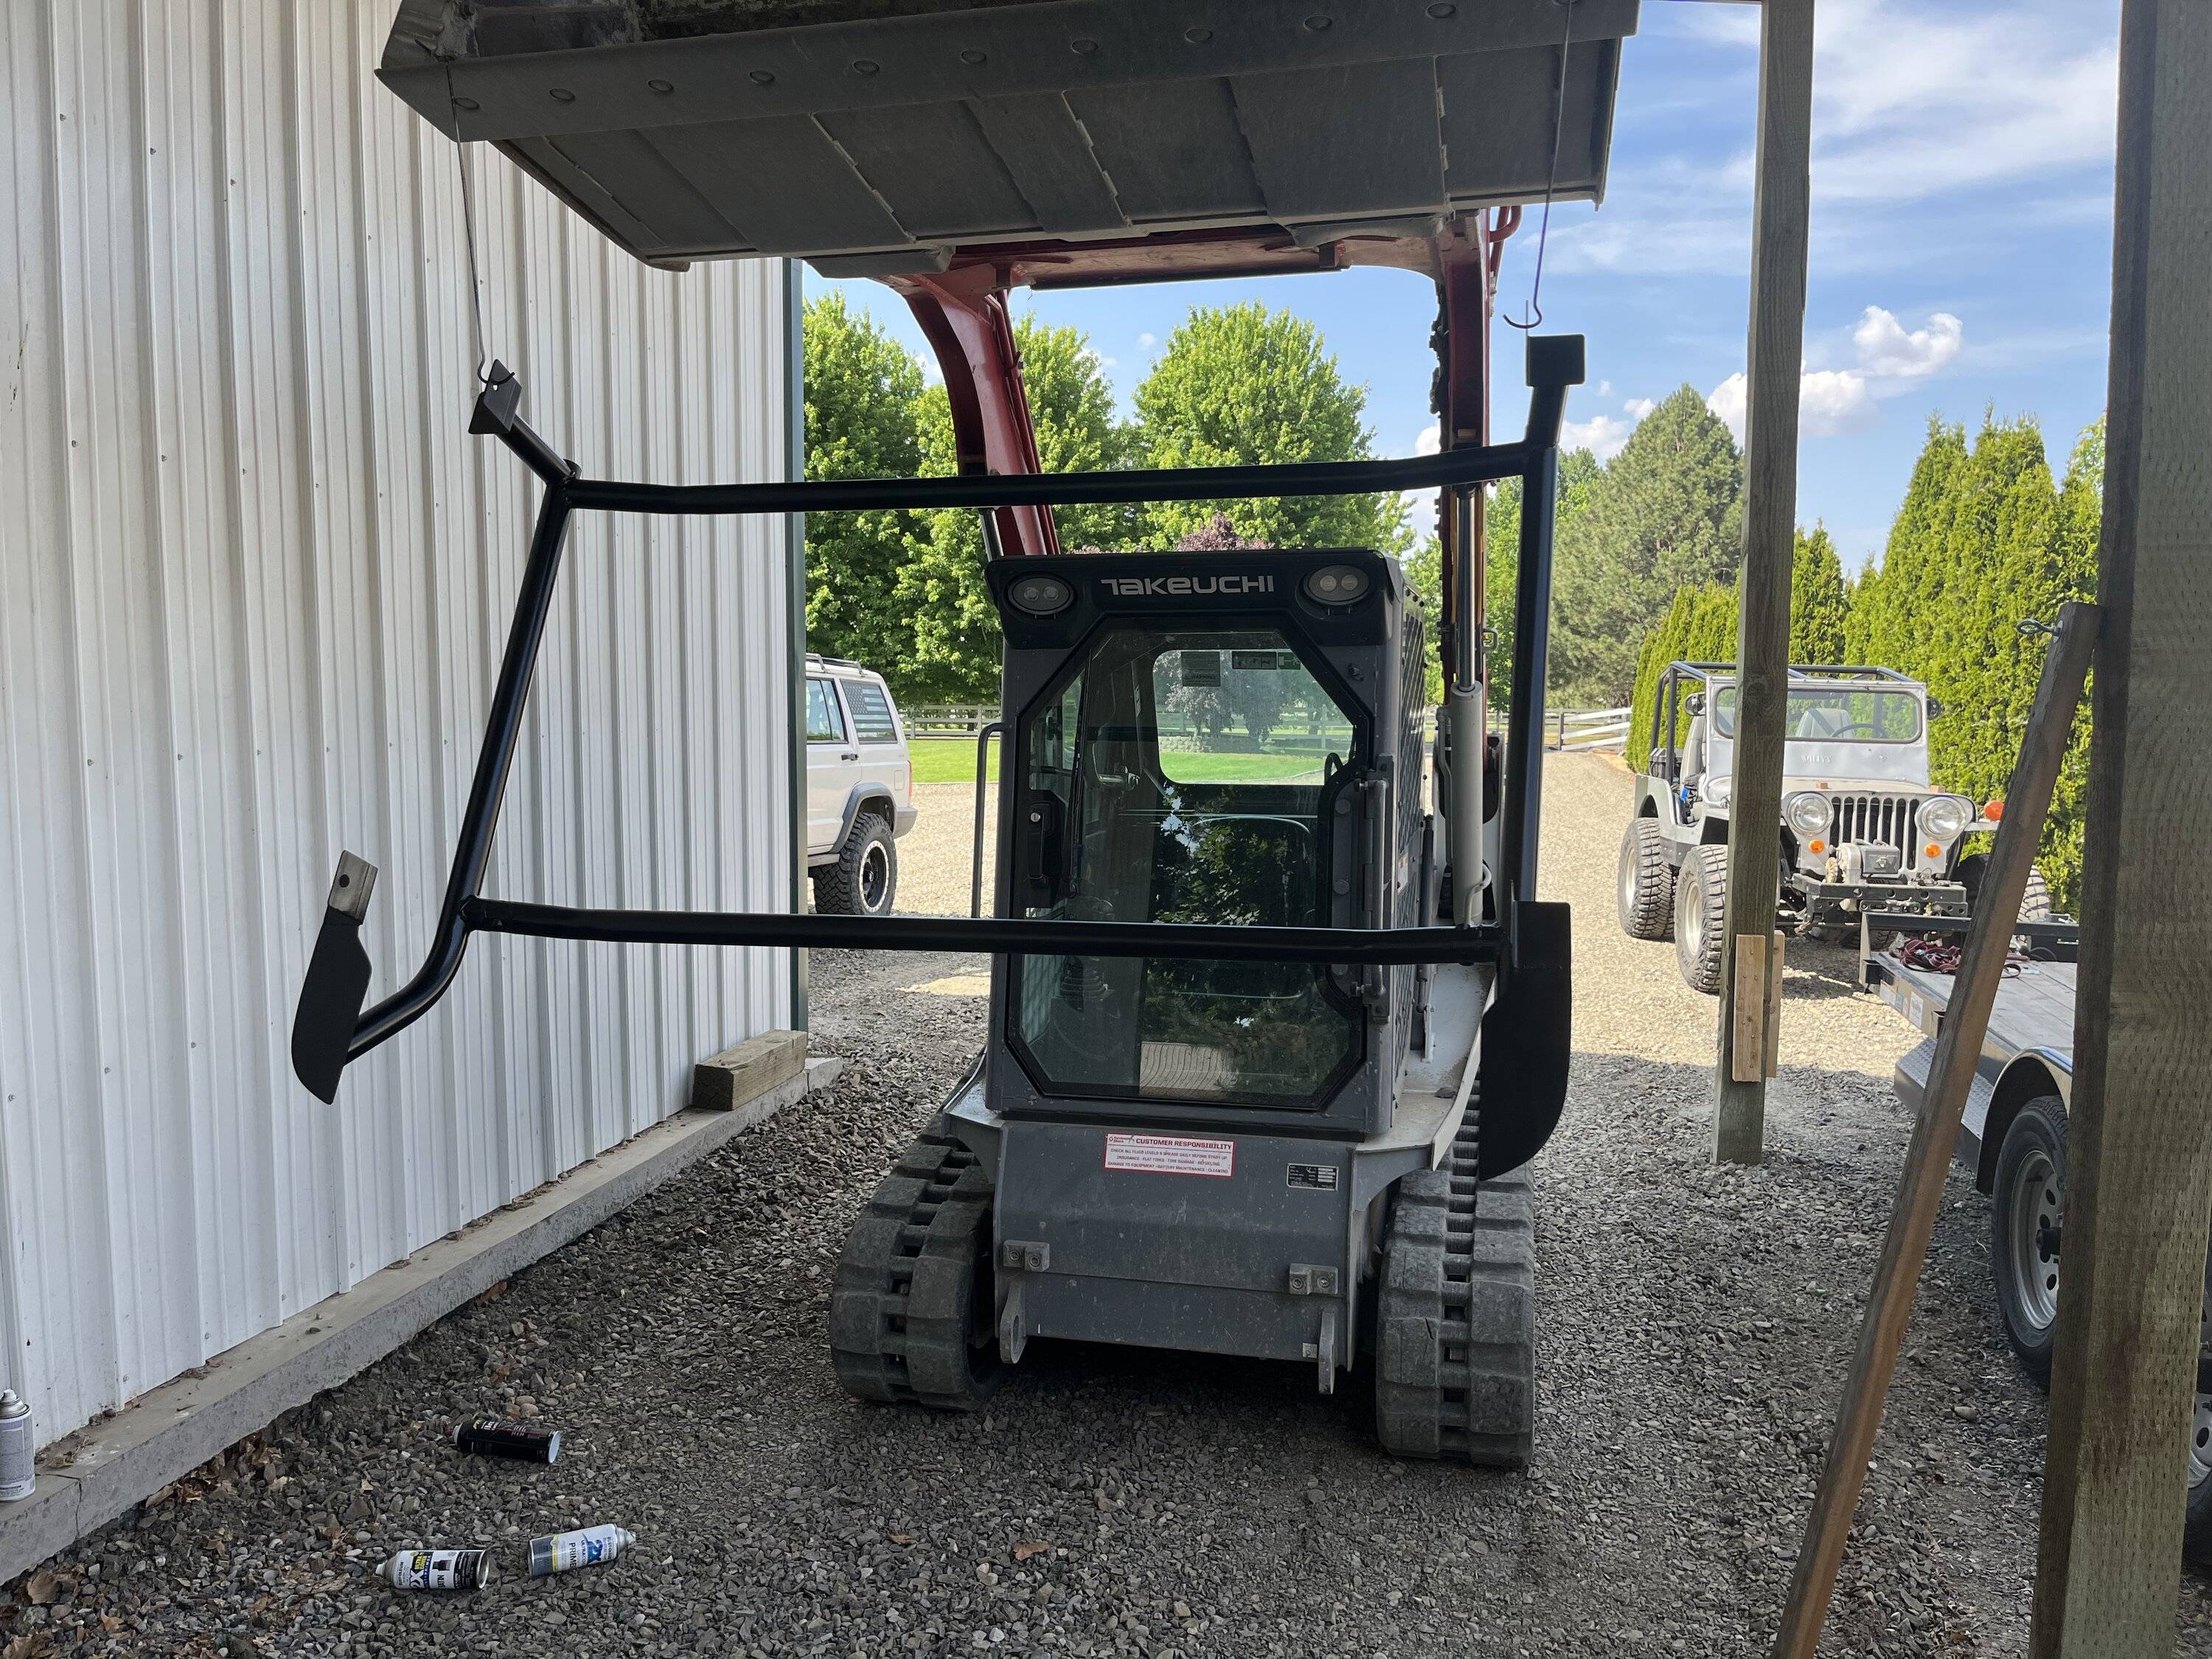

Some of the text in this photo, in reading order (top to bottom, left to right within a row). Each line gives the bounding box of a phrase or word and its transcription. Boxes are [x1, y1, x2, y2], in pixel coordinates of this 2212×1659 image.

[1101, 575, 1274, 596] TAKEUCHI
[1175, 1141, 1232, 1150] RESPONSIBILITY
[568, 1543, 577, 1569] PRIME
[587, 1539, 603, 1565] 2X
[409, 1569, 425, 1588] 2X
